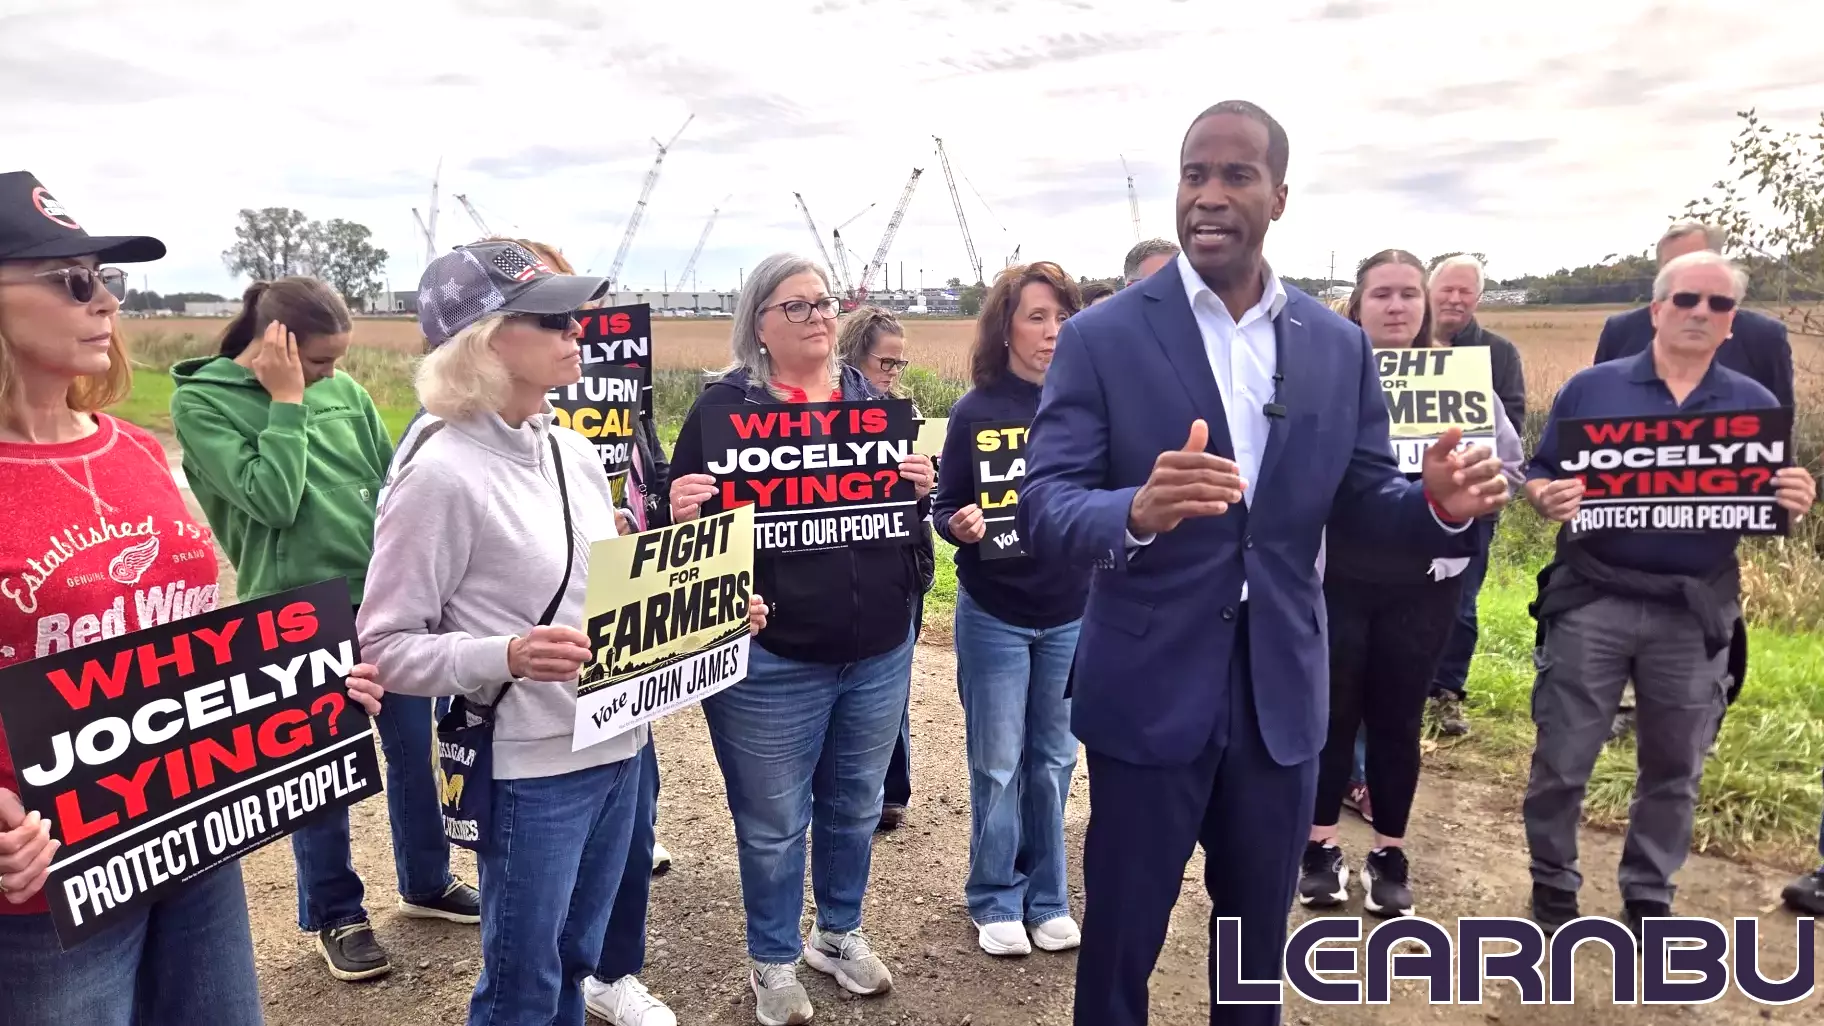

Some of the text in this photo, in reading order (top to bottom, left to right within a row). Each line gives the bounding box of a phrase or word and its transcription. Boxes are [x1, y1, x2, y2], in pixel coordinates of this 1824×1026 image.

[599, 312, 631, 336] IS
[581, 337, 648, 364] LYN
[1373, 350, 1453, 377] GHT
[1380, 380, 1408, 389] OR
[552, 407, 633, 438] OCAL
[1384, 390, 1488, 424] MERS
[729, 410, 841, 440] WHY
[850, 408, 888, 434] IS
[976, 427, 1030, 452] ST
[1583, 415, 1761, 445] WHY IS
[707, 439, 908, 475] JOCELYN
[980, 458, 1026, 483] LA
[1560, 440, 1784, 472] JOCELYN
[722, 469, 899, 510] LYING?
[1577, 467, 1772, 497] LYING?
[980, 489, 1019, 510] LA
[754, 512, 910, 550] TECT OUR PEOPLE.
[1571, 504, 1777, 533] PROTECT OUR PEOPLE.
[629, 513, 734, 579] FIGHT
[992, 529, 1020, 550] Vot
[1, 515, 161, 614] Established
[66, 549, 205, 588] GENUINE BRAND
[668, 566, 700, 587] FOR
[35, 596, 126, 659] Red
[585, 570, 750, 664] FARMERS
[46, 601, 319, 710] WHY IS
[591, 691, 628, 730] Vote
[631, 667, 685, 717] JOHN
[687, 643, 739, 695] JAMES
[22, 639, 354, 787] JOCELYN
[55, 692, 346, 846] LYING?
[63, 819, 200, 927] PROTECT
[203, 797, 267, 855] OUR
[267, 751, 367, 830] PEOPLE.
